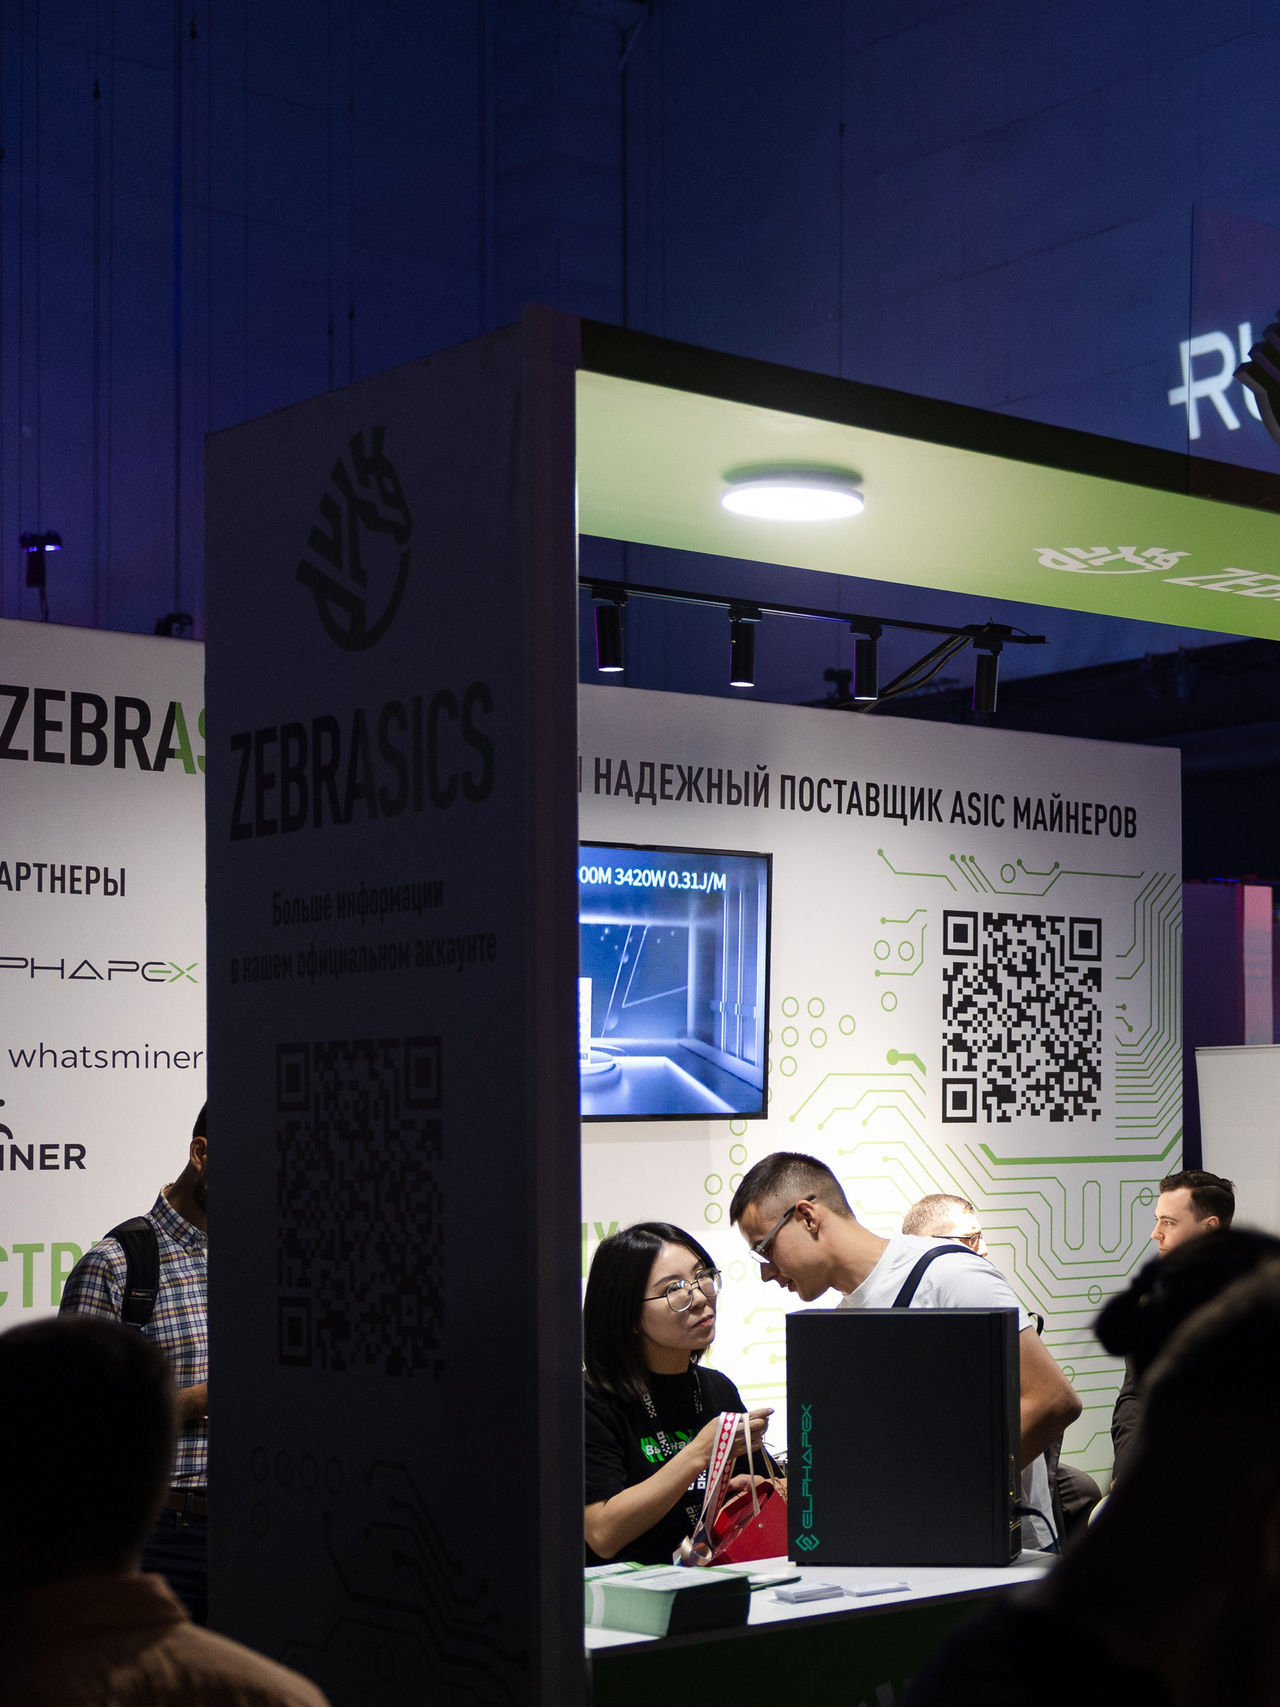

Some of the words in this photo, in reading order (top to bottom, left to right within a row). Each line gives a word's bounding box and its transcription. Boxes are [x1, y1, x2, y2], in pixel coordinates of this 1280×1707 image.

[0, 685, 206, 775] ZEBRA
[230, 681, 495, 842] ZEBRASICS
[593, 756, 770, 808] НАДЕЖНЫЙ
[779, 774, 943, 826] ПОСТАВЩИК
[949, 790, 1006, 828] ASIC
[1012, 792, 1138, 838] МАЙНЕРОВ
[272, 890, 332, 927] Больше
[337, 880, 444, 925] информации
[614, 868, 668, 888] 3420W
[668, 871, 727, 893] 0.31J/M
[231, 957, 239, 984] в
[243, 952, 293, 982] нашем
[297, 941, 411, 985] официальном
[415, 932, 498, 973] аккаунте
[8, 1042, 204, 1070] whatsminer
[801, 1404, 813, 1529] ELPHAPEX
